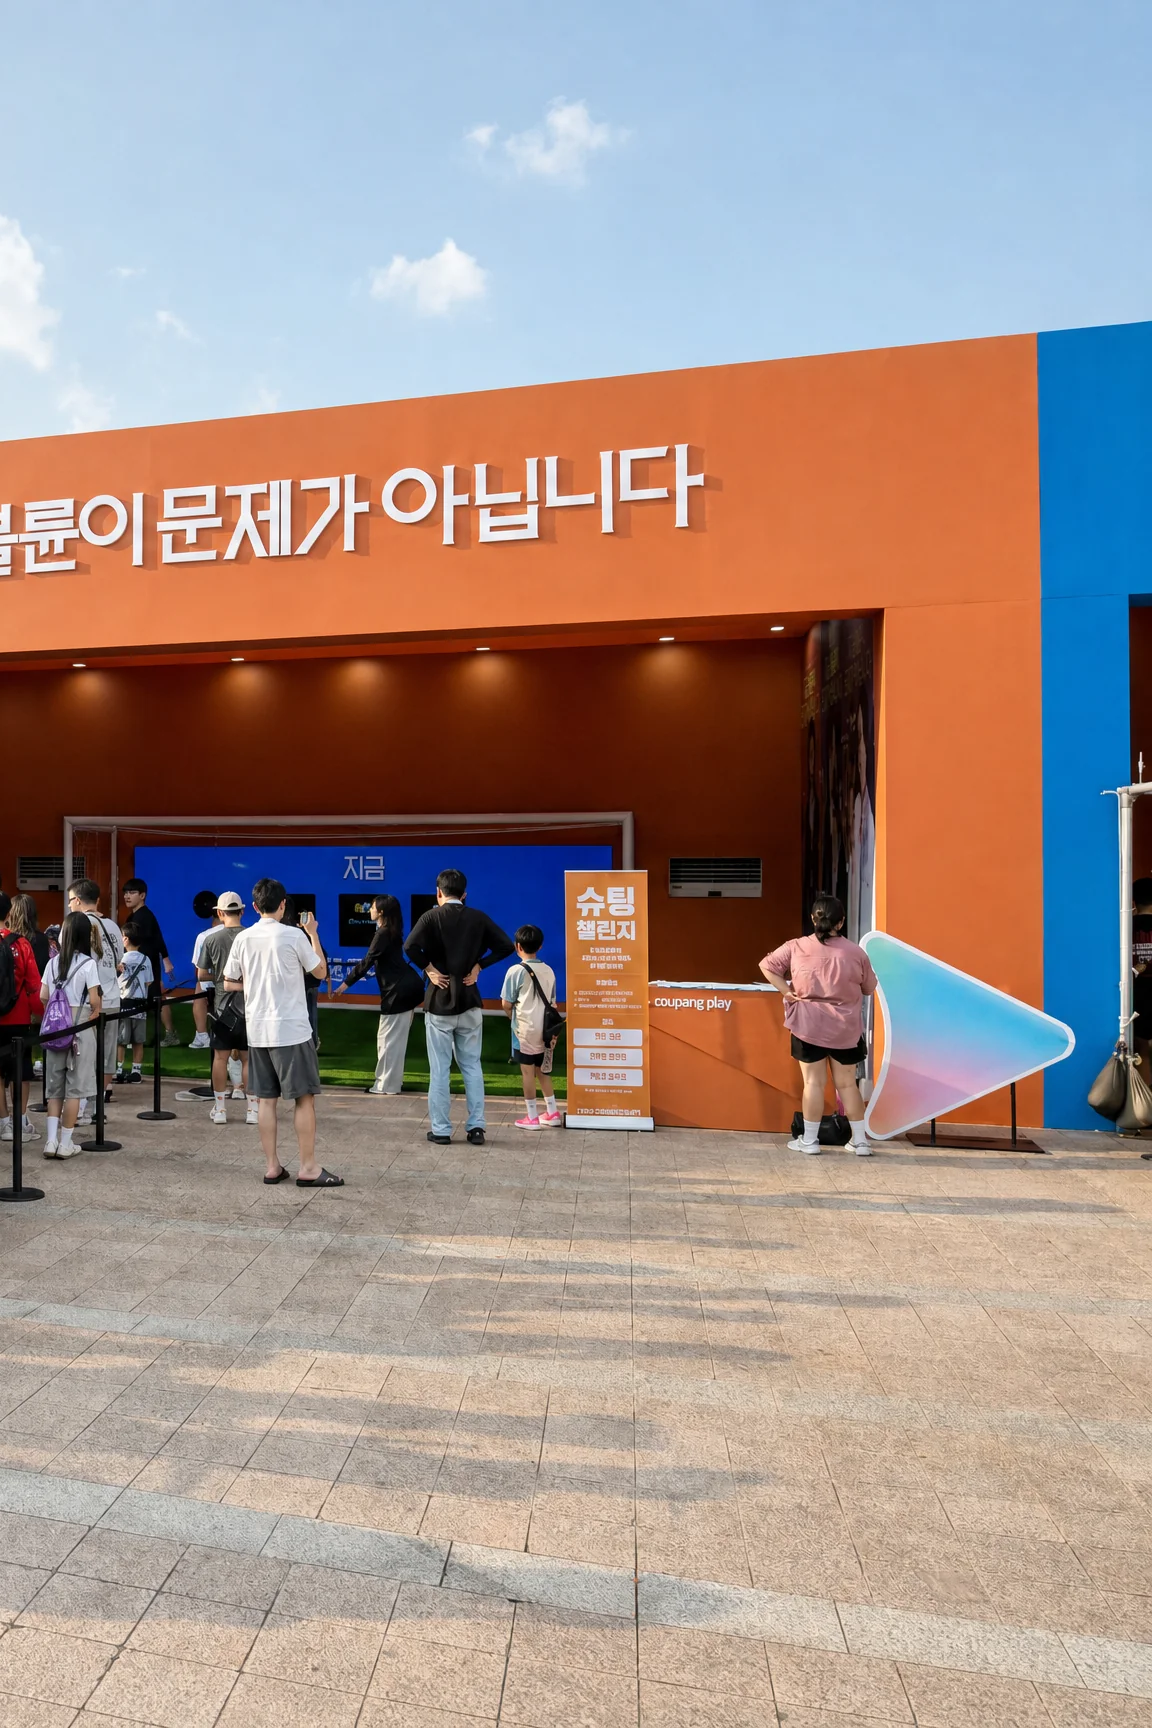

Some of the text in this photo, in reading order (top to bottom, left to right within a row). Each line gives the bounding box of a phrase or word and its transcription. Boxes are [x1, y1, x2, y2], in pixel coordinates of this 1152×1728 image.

[156, 473, 370, 564] 문제가
[381, 443, 705, 546] 아닙니다
[343, 855, 385, 881] 지금
[576, 886, 635, 917] 슈팅
[576, 919, 636, 941] 챌린지
[654, 996, 732, 1012] coupang play
